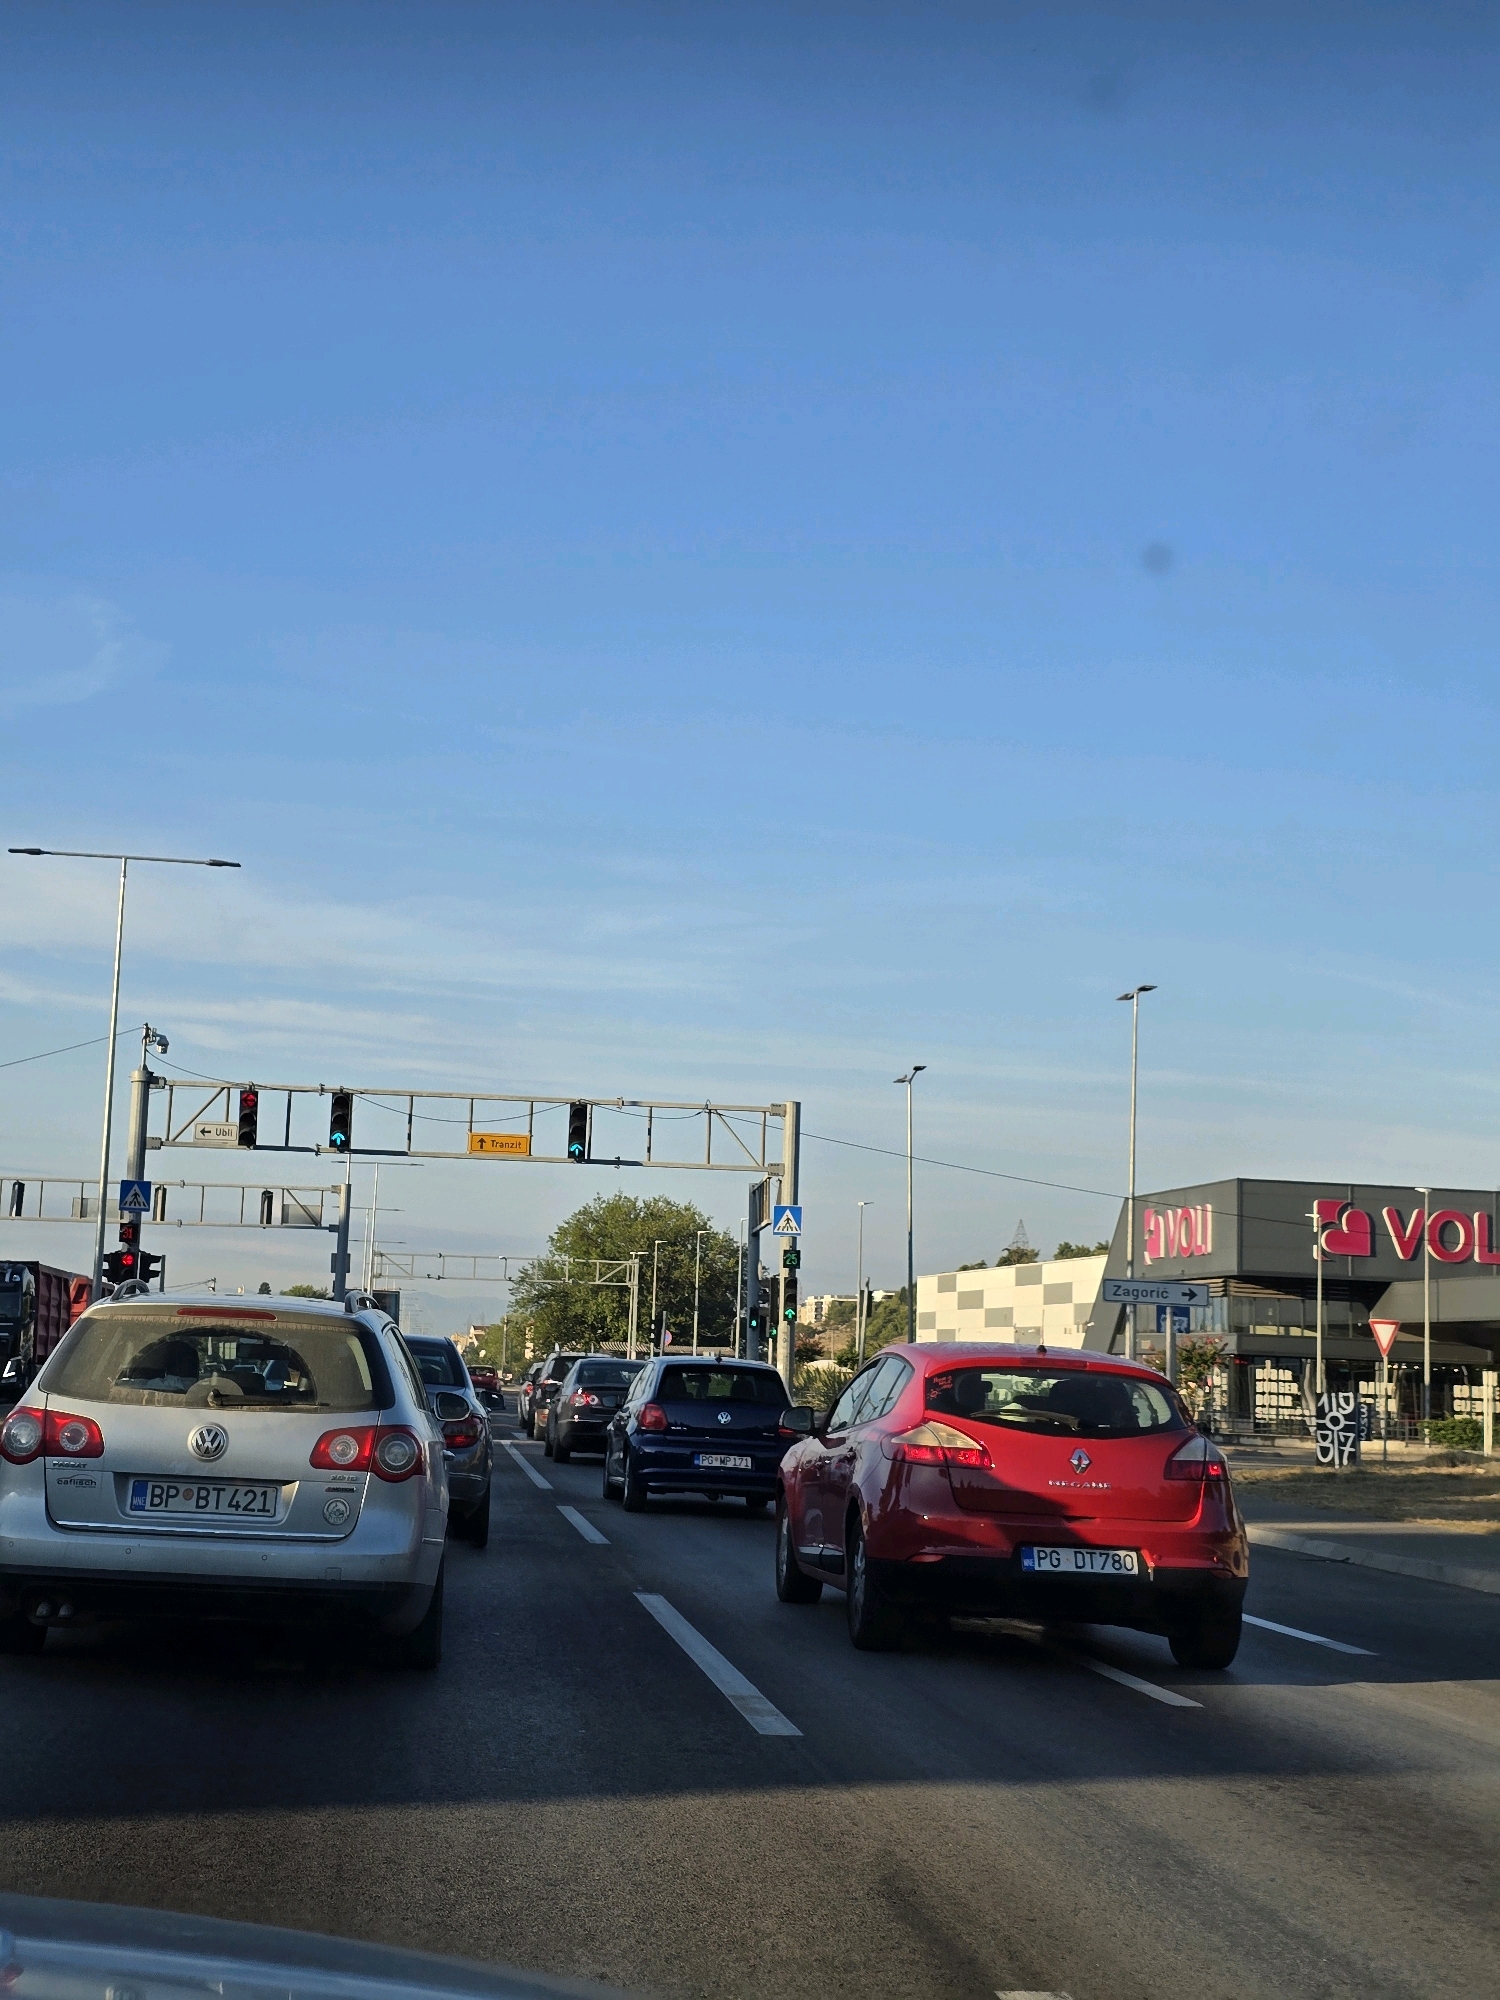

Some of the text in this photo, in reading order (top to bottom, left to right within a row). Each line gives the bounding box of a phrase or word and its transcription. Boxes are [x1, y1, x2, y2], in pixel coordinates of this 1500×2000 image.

[215, 1127, 233, 1137] Ubli
[491, 1139, 522, 1149] Tranzit
[122, 1226, 133, 1239] 31
[1164, 1204, 1213, 1259] VOLI
[785, 1253, 798, 1265] 25
[52, 1461, 88, 1469] PASSAT
[701, 1455, 714, 1465] PG
[132, 1496, 146, 1506] MNE
[150, 1485, 180, 1509] BP
[1036, 1550, 1135, 1572] PG DT780
